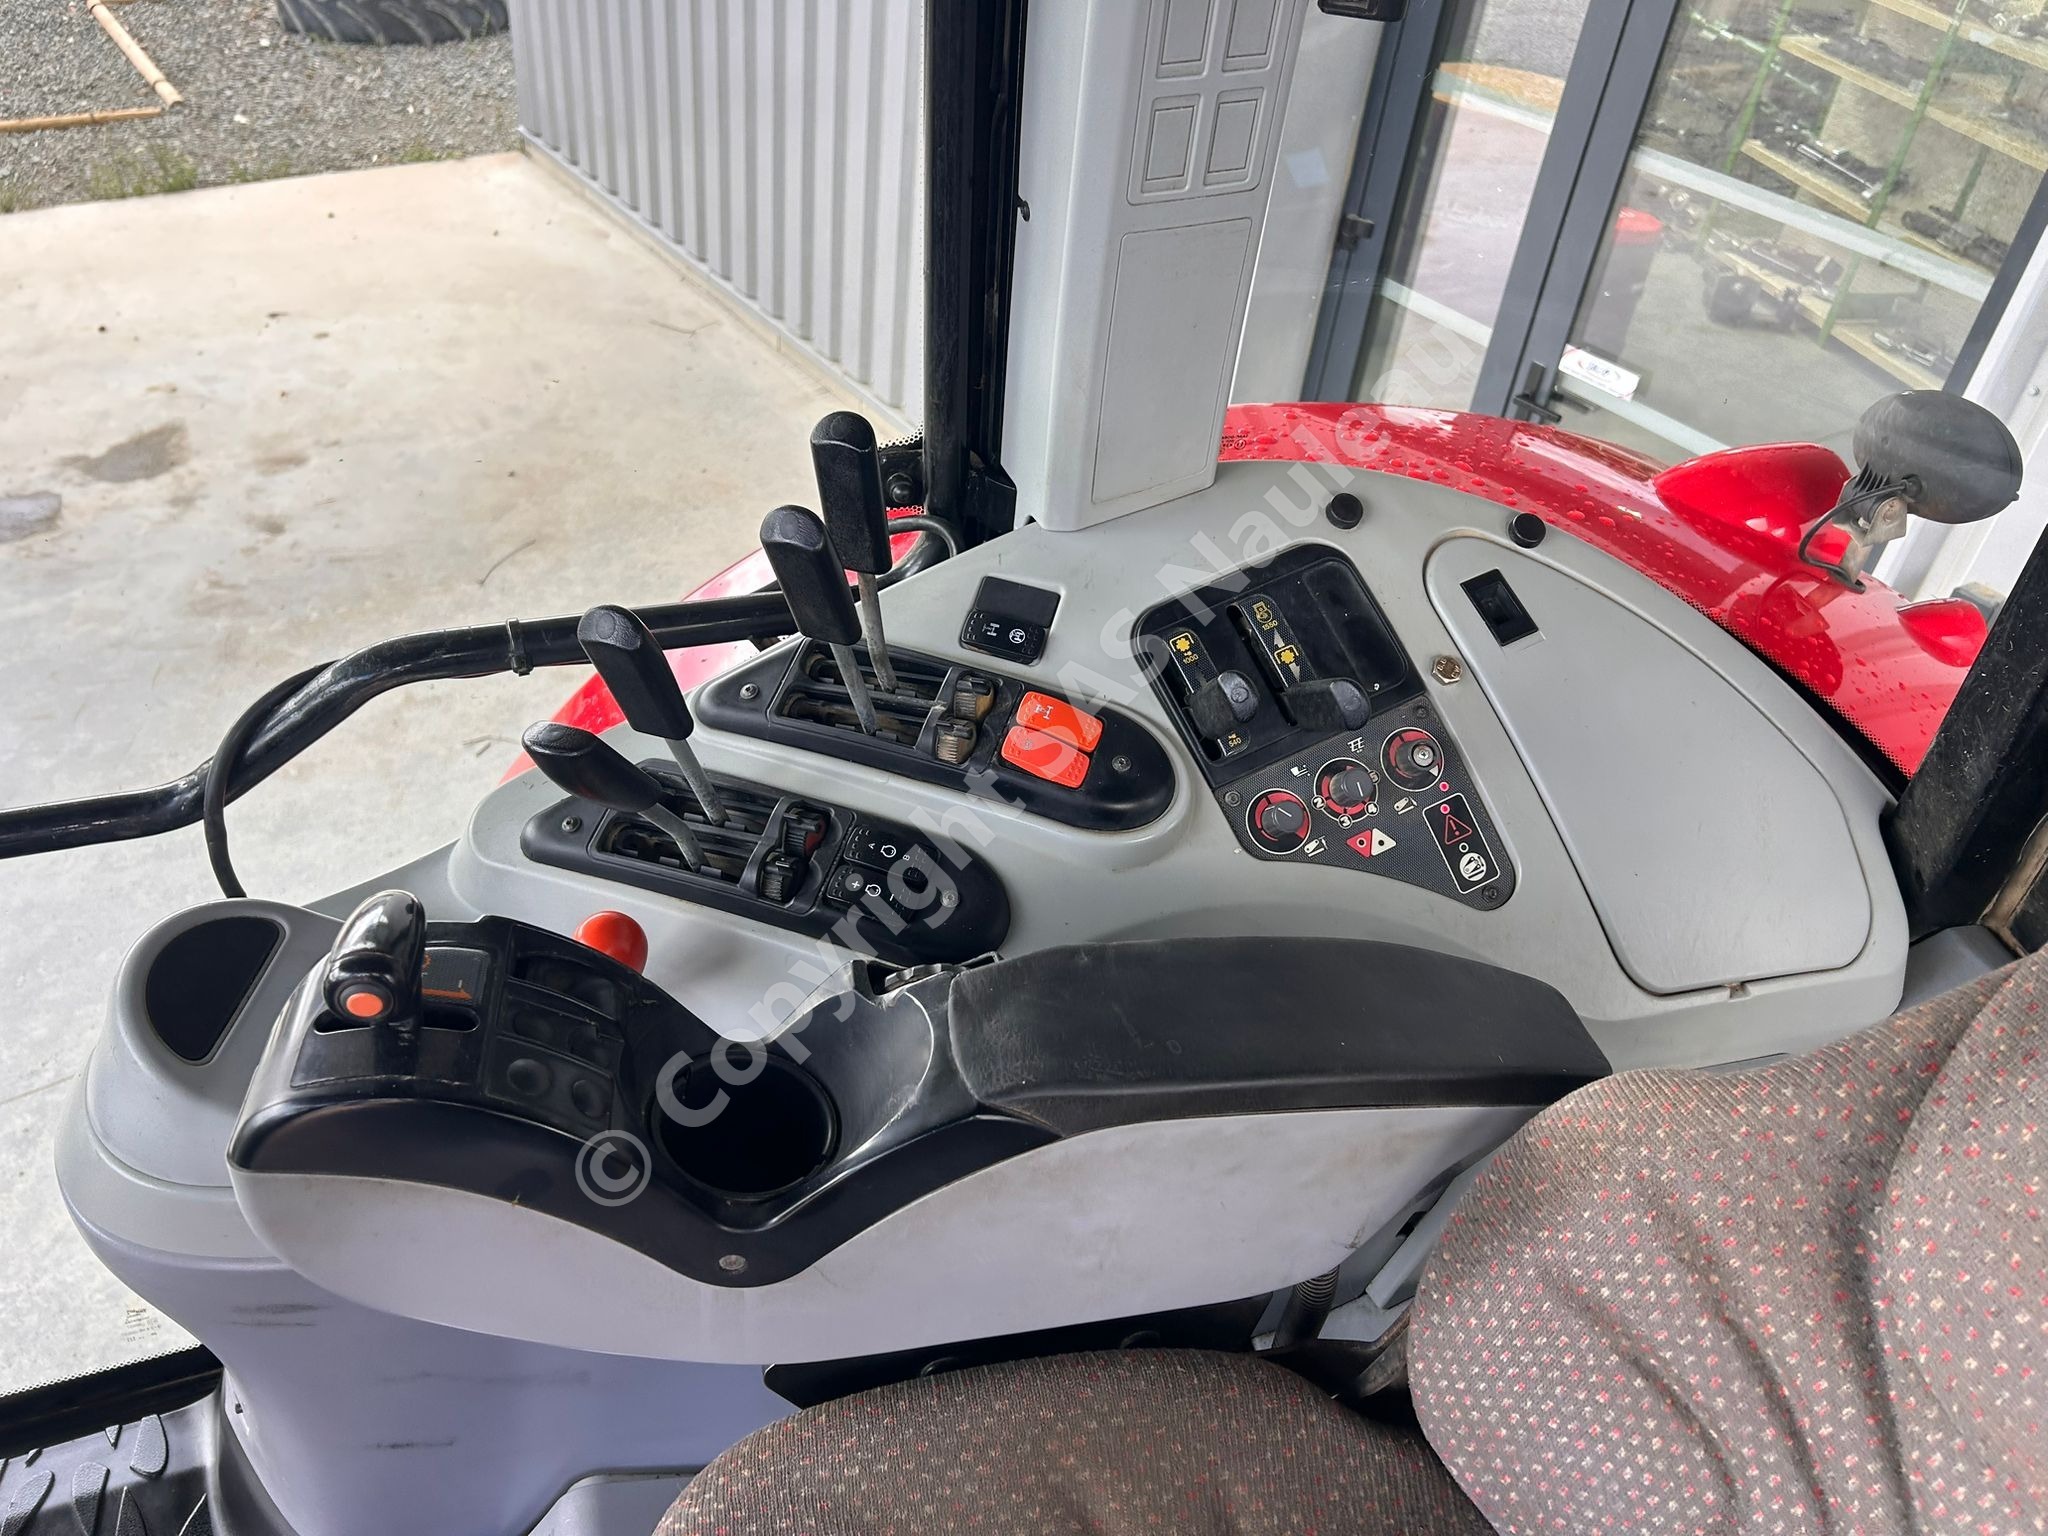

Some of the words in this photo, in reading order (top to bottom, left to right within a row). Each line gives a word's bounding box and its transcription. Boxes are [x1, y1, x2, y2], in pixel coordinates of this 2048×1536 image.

[1183, 653, 1199, 665] 1000
[1228, 737, 1242, 748] 540
[1369, 770, 1379, 783] 5
[1313, 797, 1325, 809] 2
[1367, 803, 1378, 814] 4
[1339, 815, 1351, 827] 3
